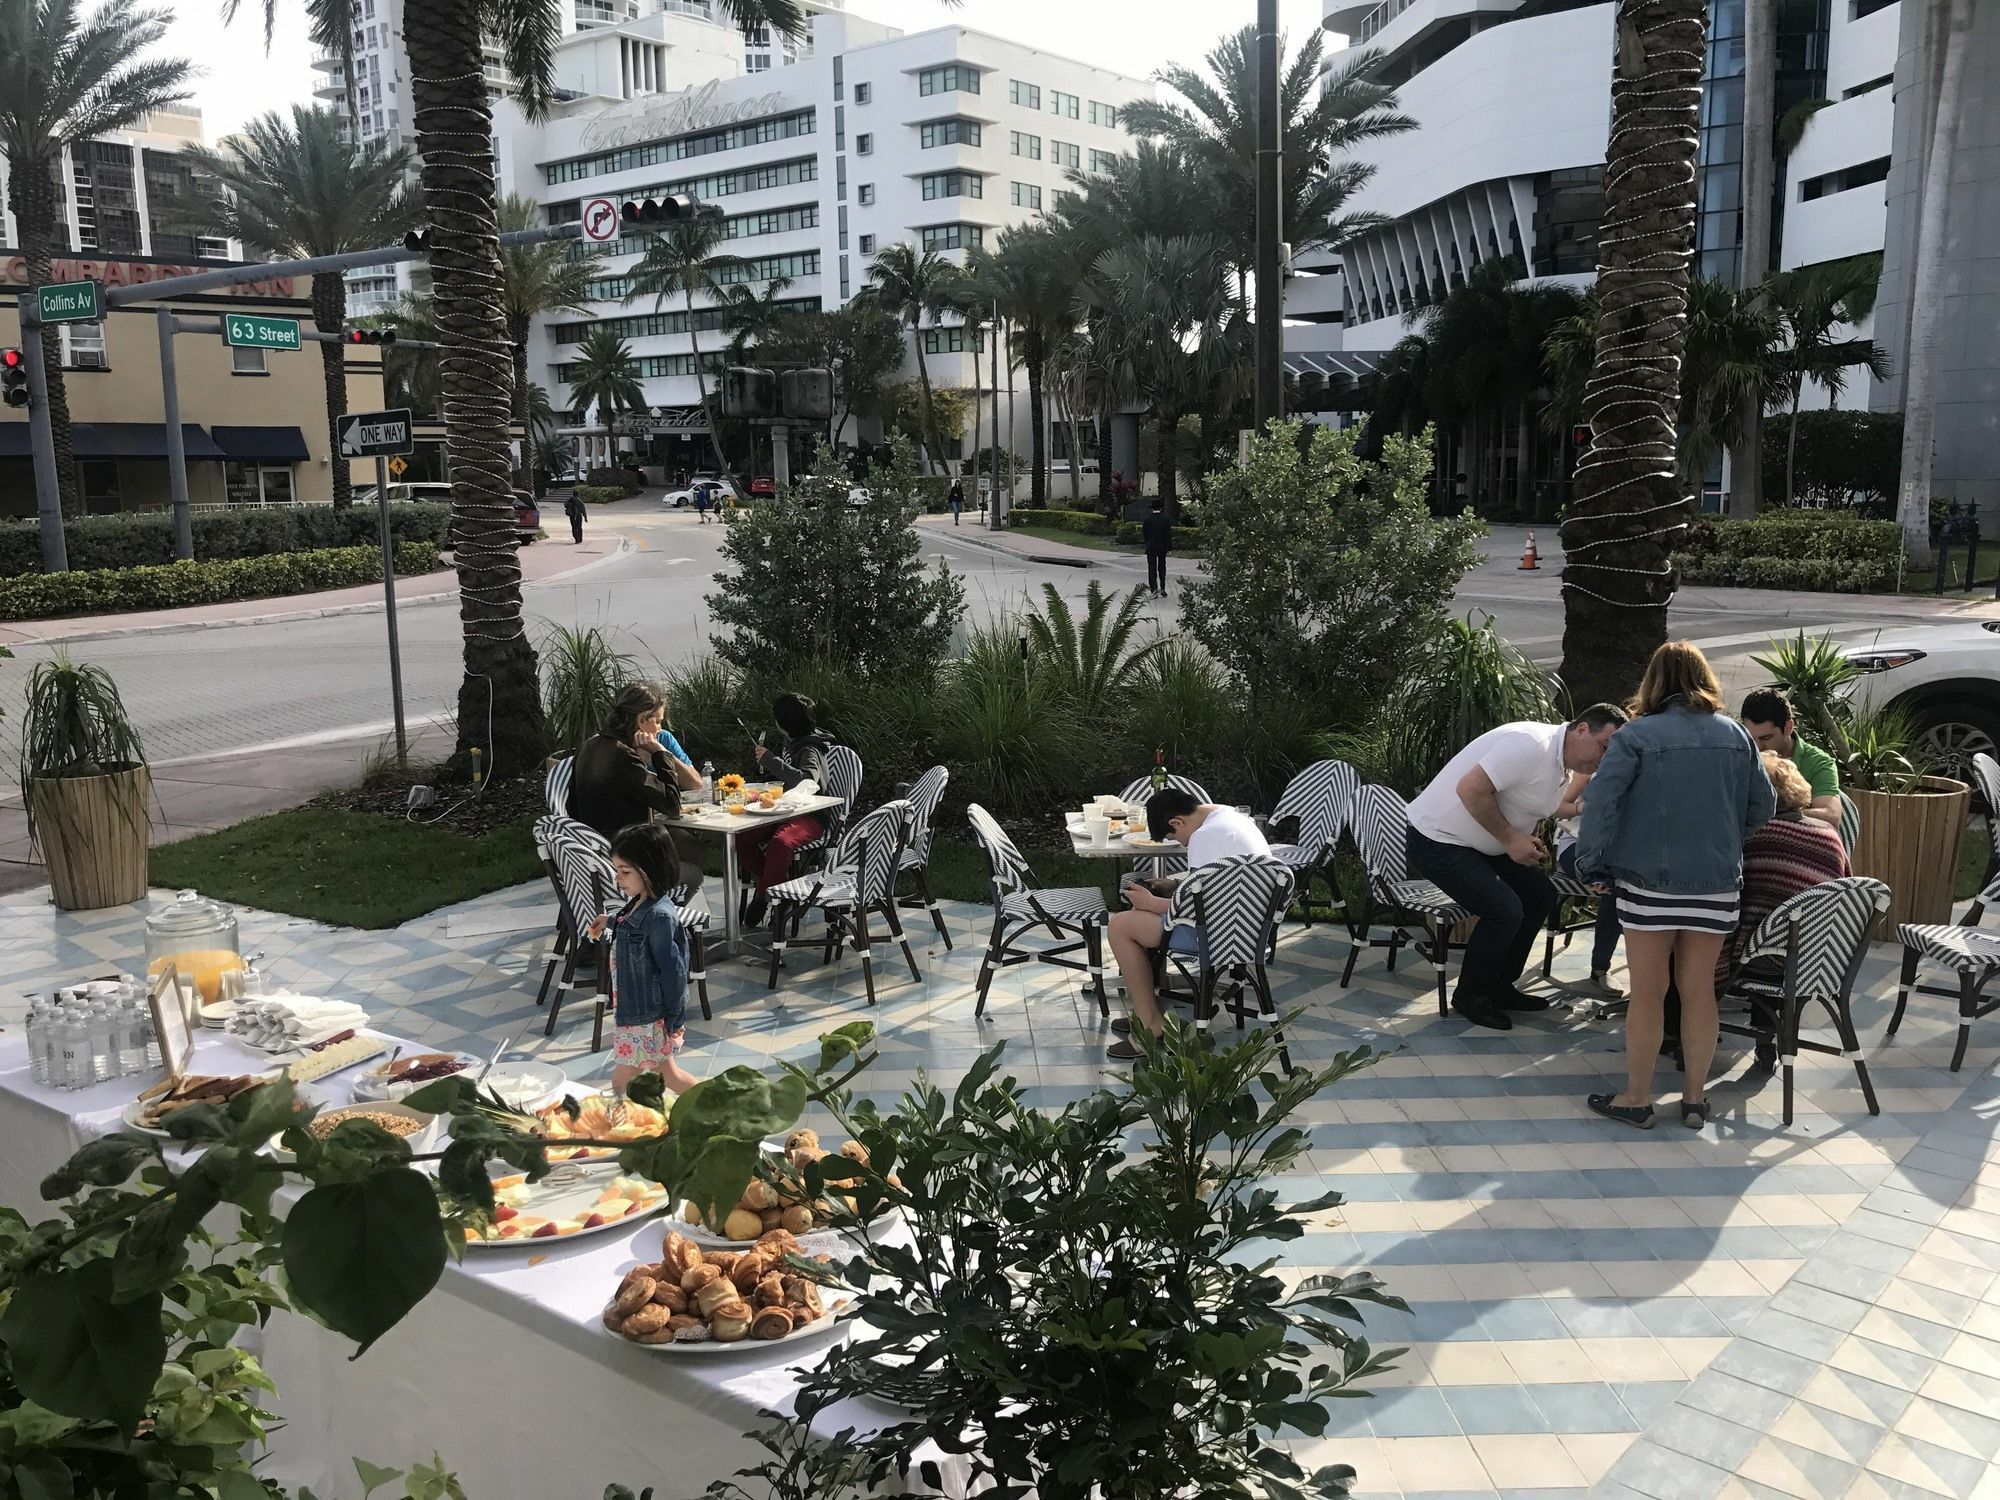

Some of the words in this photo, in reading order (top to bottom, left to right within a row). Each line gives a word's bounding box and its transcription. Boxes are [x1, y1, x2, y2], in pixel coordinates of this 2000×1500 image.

[43, 294, 76, 312] Collins
[78, 292, 91, 309] Av
[232, 322, 255, 339] 63
[259, 326, 296, 343] Street
[361, 426, 381, 443] ONE
[384, 423, 404, 441] WAY
